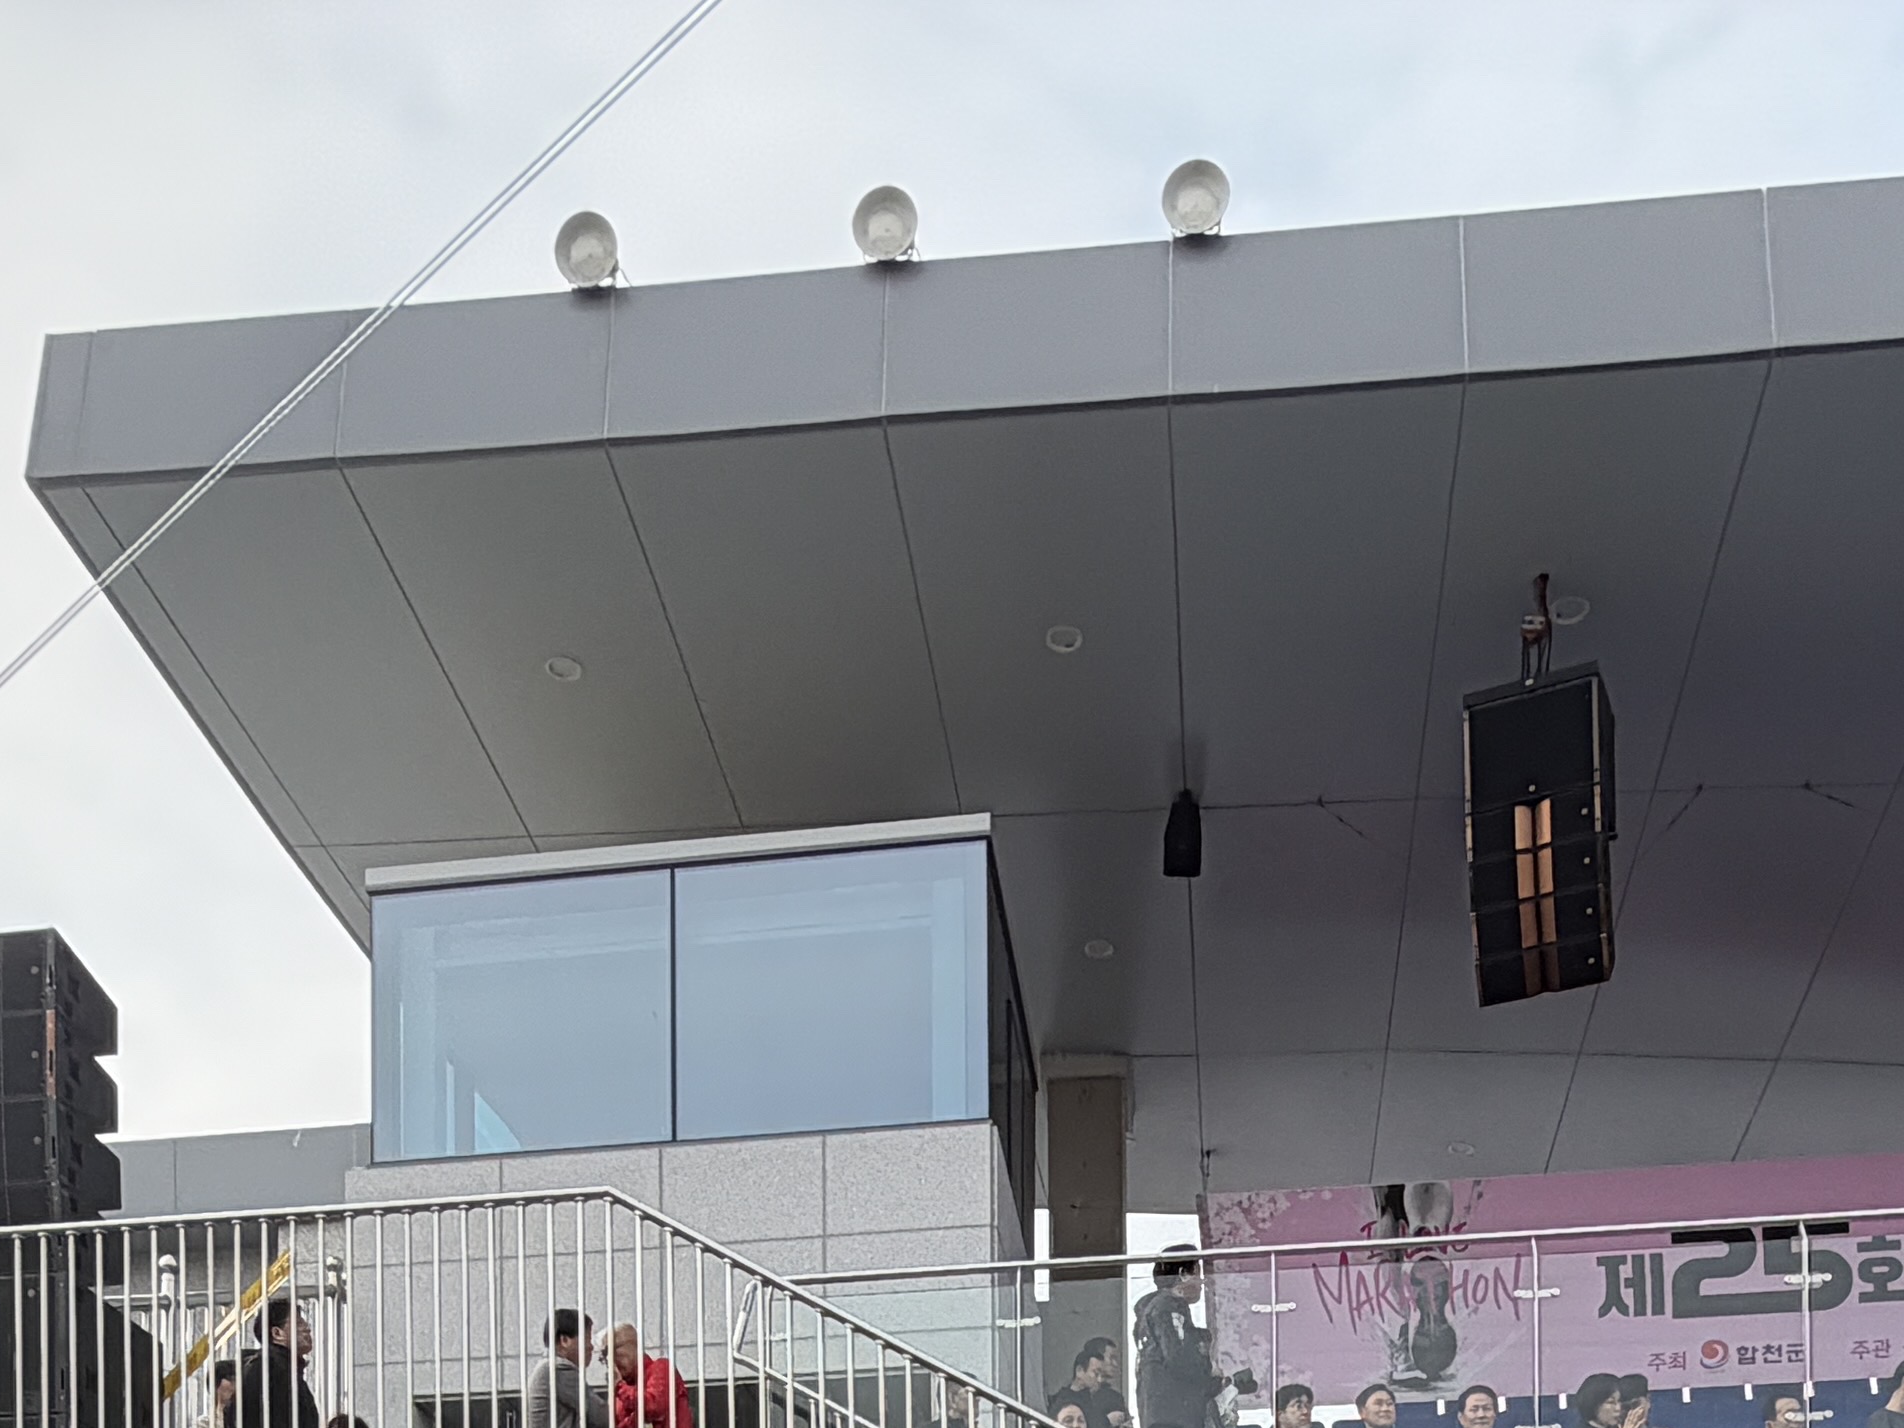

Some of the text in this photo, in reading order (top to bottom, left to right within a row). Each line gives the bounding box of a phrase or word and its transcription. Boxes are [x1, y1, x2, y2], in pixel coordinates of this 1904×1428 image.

[1647, 1343, 1805, 1372] 주최 합천군
[1849, 1338, 1892, 1359] 주관
